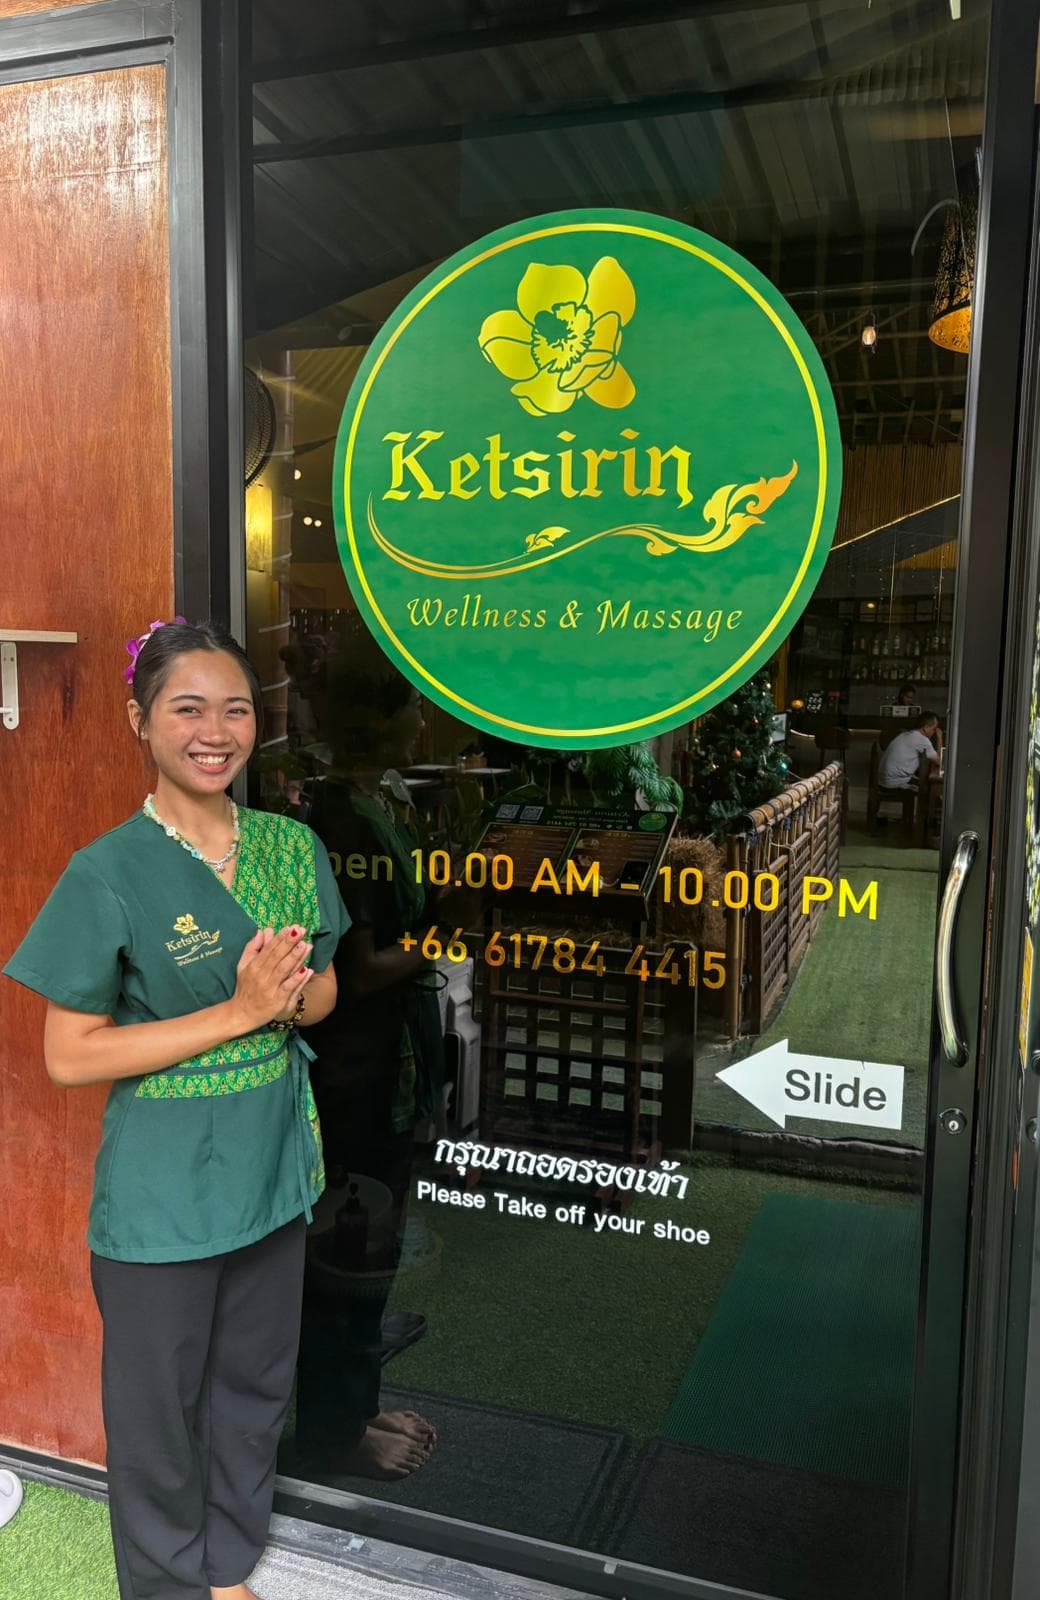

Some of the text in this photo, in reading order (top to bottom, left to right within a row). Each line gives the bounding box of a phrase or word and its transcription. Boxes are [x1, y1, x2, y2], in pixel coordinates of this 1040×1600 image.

[382, 428, 695, 509] Ketsirin
[406, 594, 744, 643] Wellness & Massage
[328, 850, 394, 882] en
[410, 848, 515, 891] 10.00
[530, 856, 601, 898] AM
[658, 865, 781, 912] 10.00
[801, 875, 880, 921] PM
[398, 925, 727, 990] +66 61784 4415
[783, 1068, 888, 1112] Slide
[434, 1138, 690, 1200] กรุณาถอดรองเท้า
[416, 1180, 711, 1246] Please Take off your shoe
